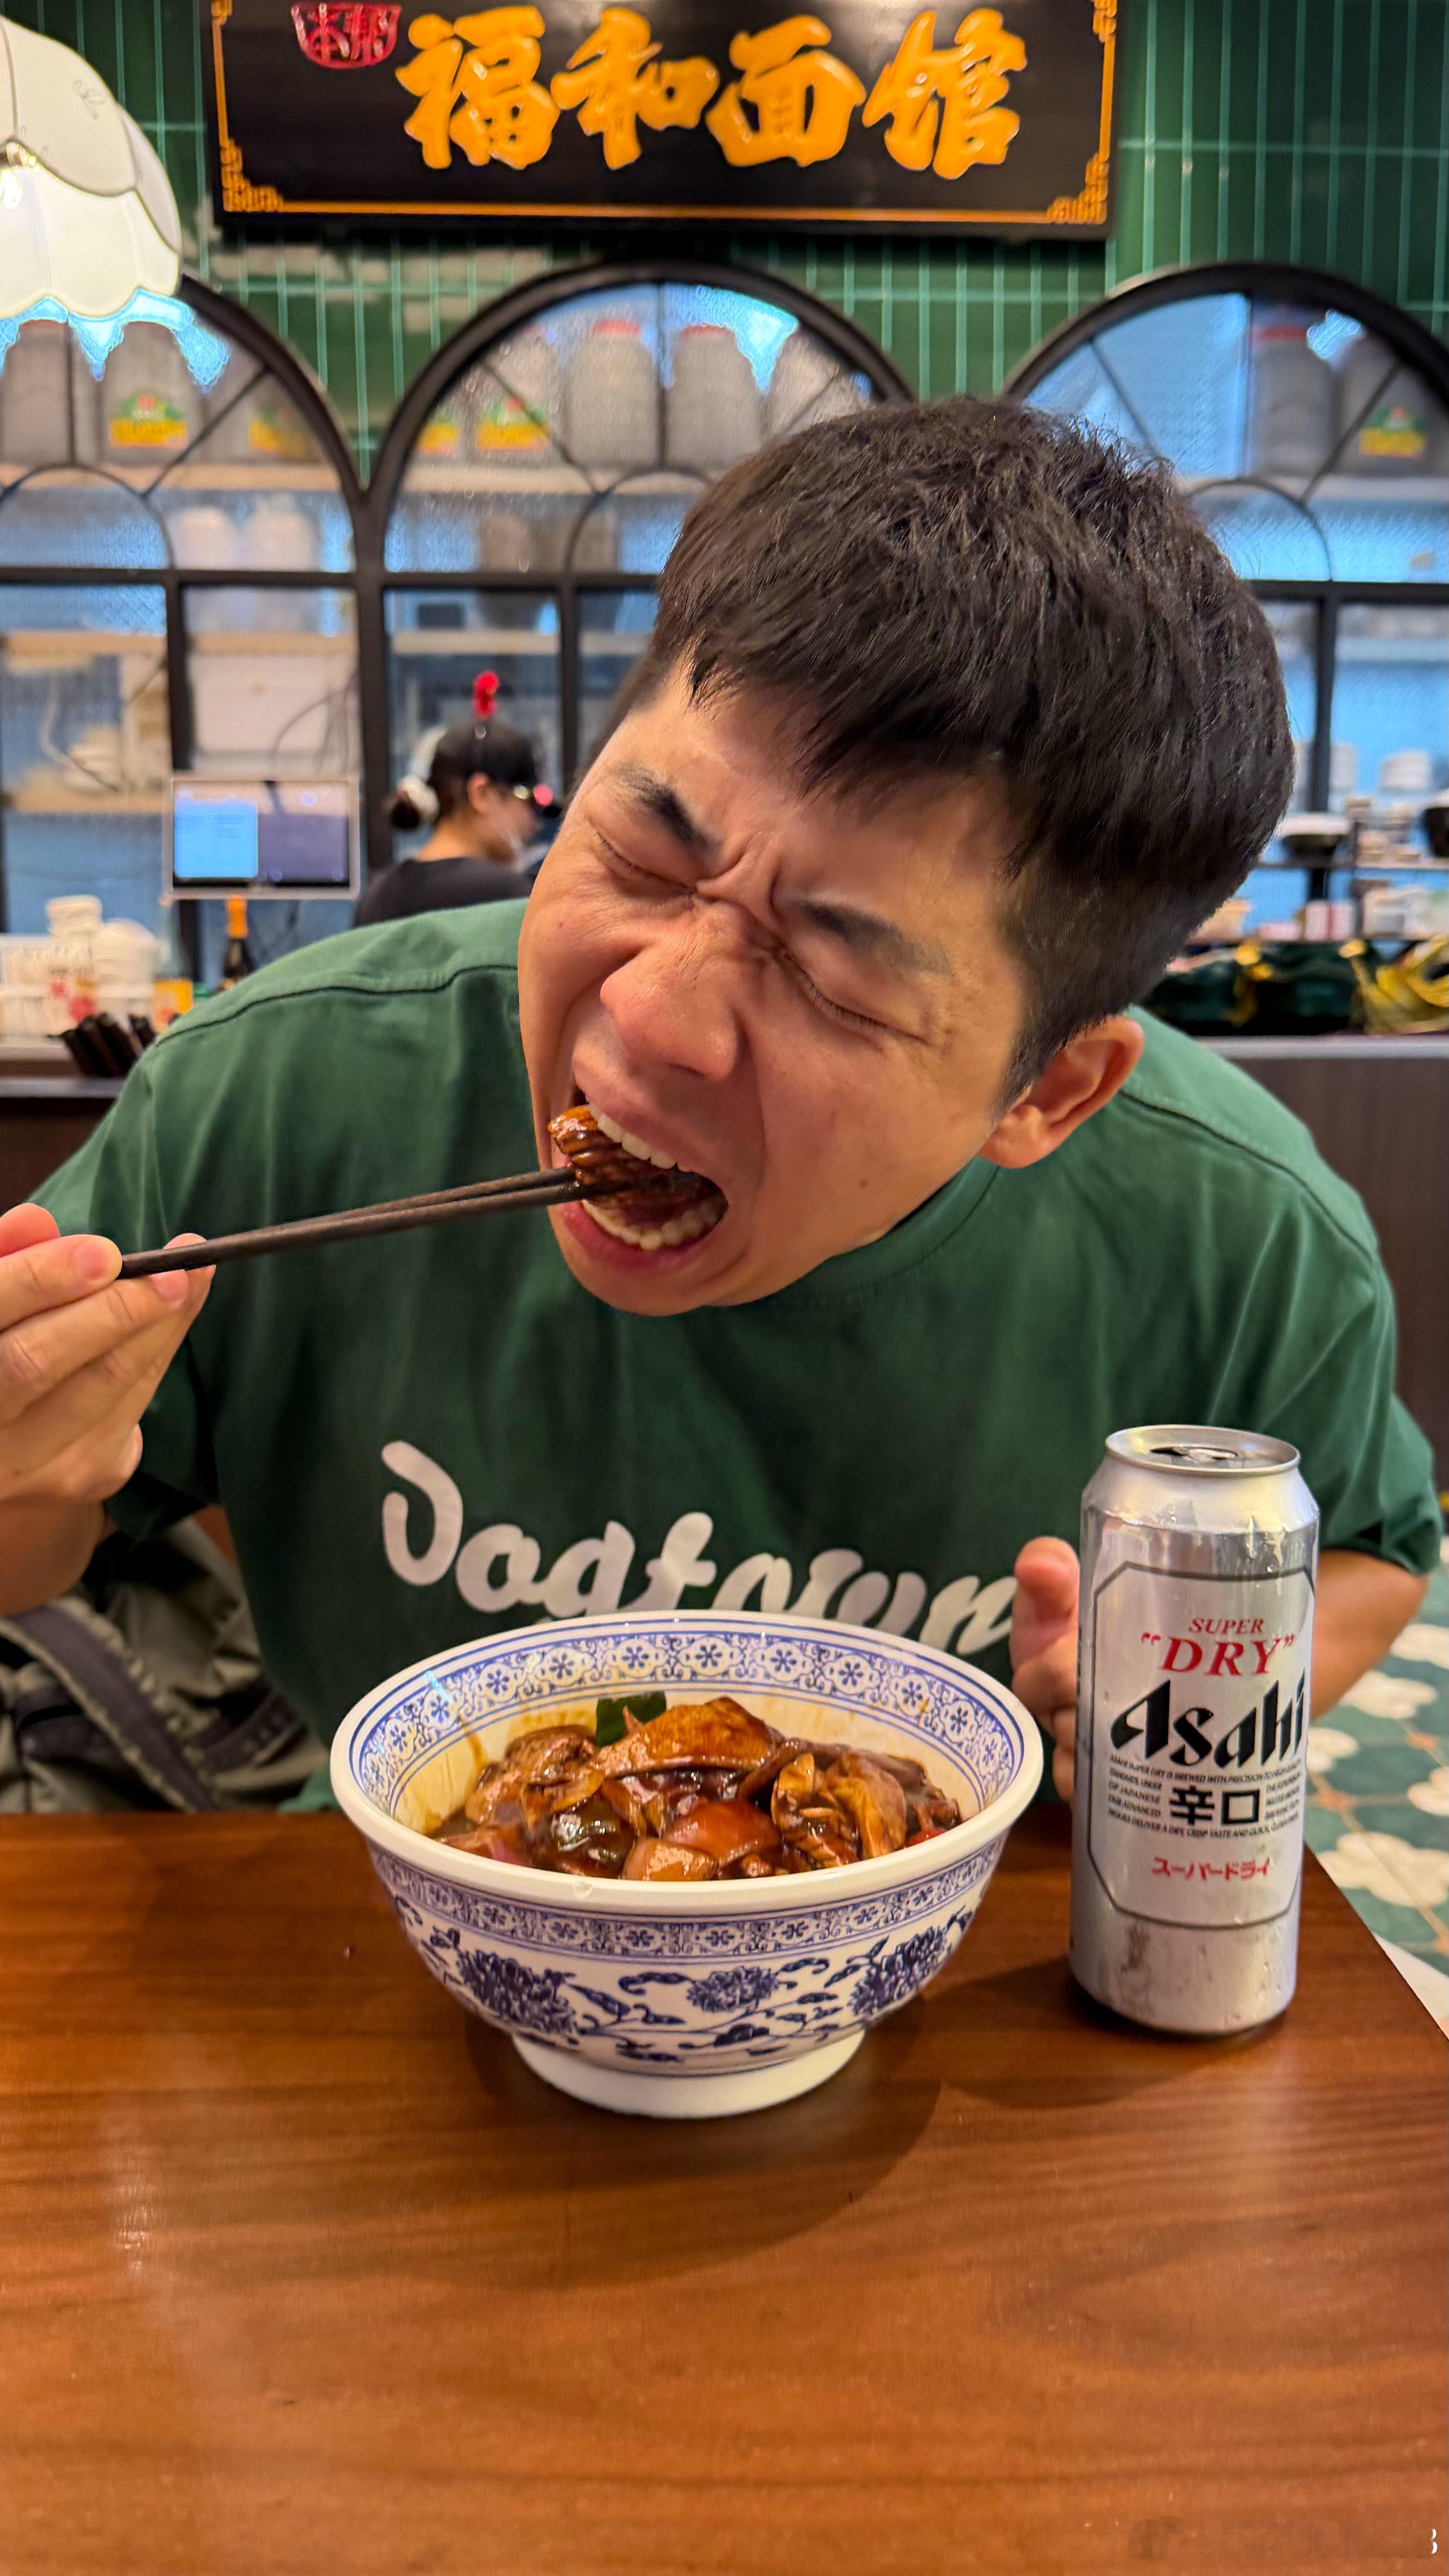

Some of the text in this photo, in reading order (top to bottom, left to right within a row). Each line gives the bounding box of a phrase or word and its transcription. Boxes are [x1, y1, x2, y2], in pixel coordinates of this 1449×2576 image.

[396, 5, 1027, 179] 福和面馆
[1188, 1618, 1264, 1634] SUPER
[1110, 1667, 1305, 1769] Asahi
[1174, 1772, 1206, 1783] BREWED
[1207, 1775, 1227, 1784] WITH
[1168, 1784, 1261, 1826] 辛口
[1151, 1856, 1270, 1881] スーパードライ
